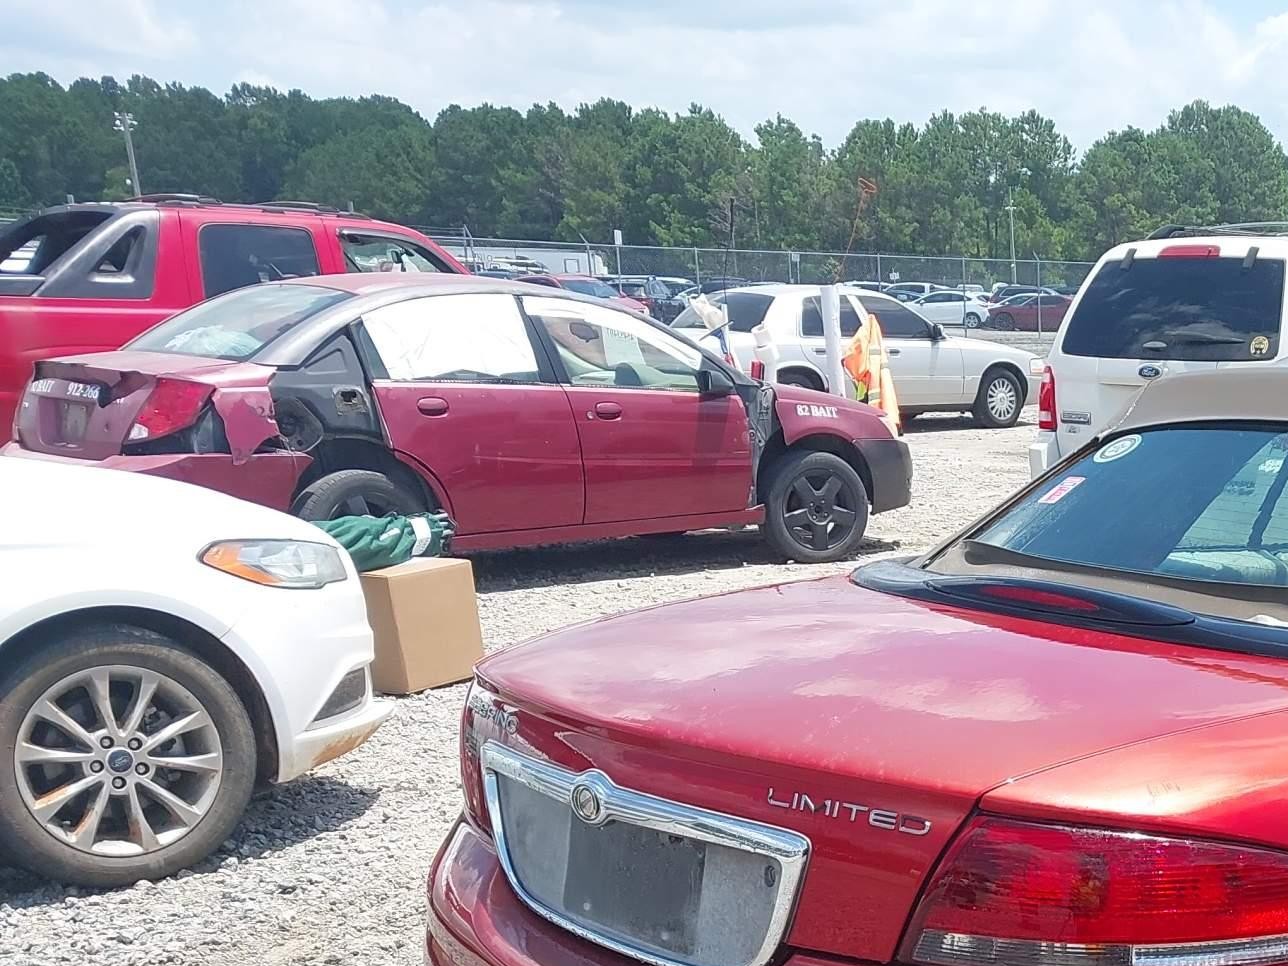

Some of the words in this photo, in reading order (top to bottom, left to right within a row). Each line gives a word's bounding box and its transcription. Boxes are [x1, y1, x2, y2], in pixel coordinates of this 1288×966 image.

[796, 404, 810, 416] 82
[810, 405, 839, 418] BAIT
[767, 787, 932, 836] LIMITED
